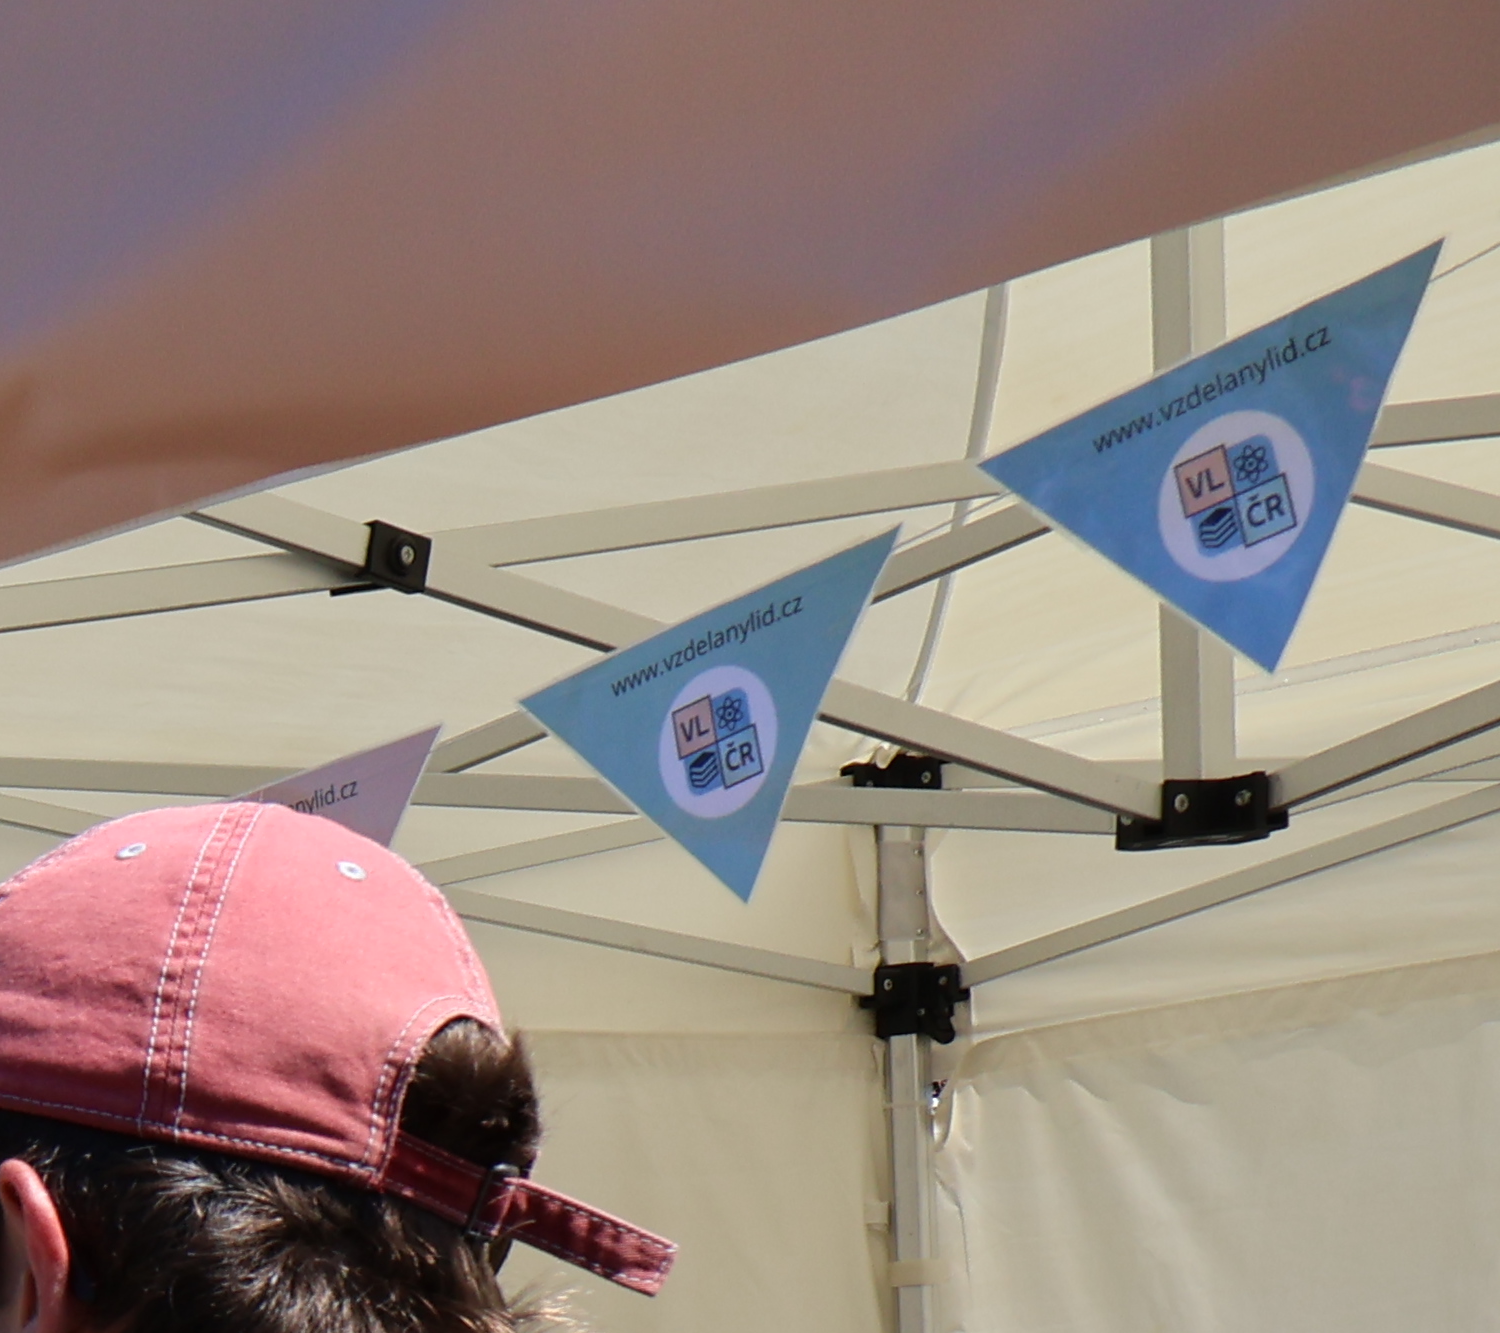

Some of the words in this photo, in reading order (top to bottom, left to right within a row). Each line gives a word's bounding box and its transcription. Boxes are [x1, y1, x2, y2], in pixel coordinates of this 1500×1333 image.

[1092, 322, 1332, 454] www.vzdelanylid.cz
[1186, 468, 1224, 502] VL
[1246, 488, 1286, 529] ČR
[609, 592, 804, 698] www.vzdelanylid.cz
[678, 713, 709, 746] VL
[724, 735, 757, 779] ČR
